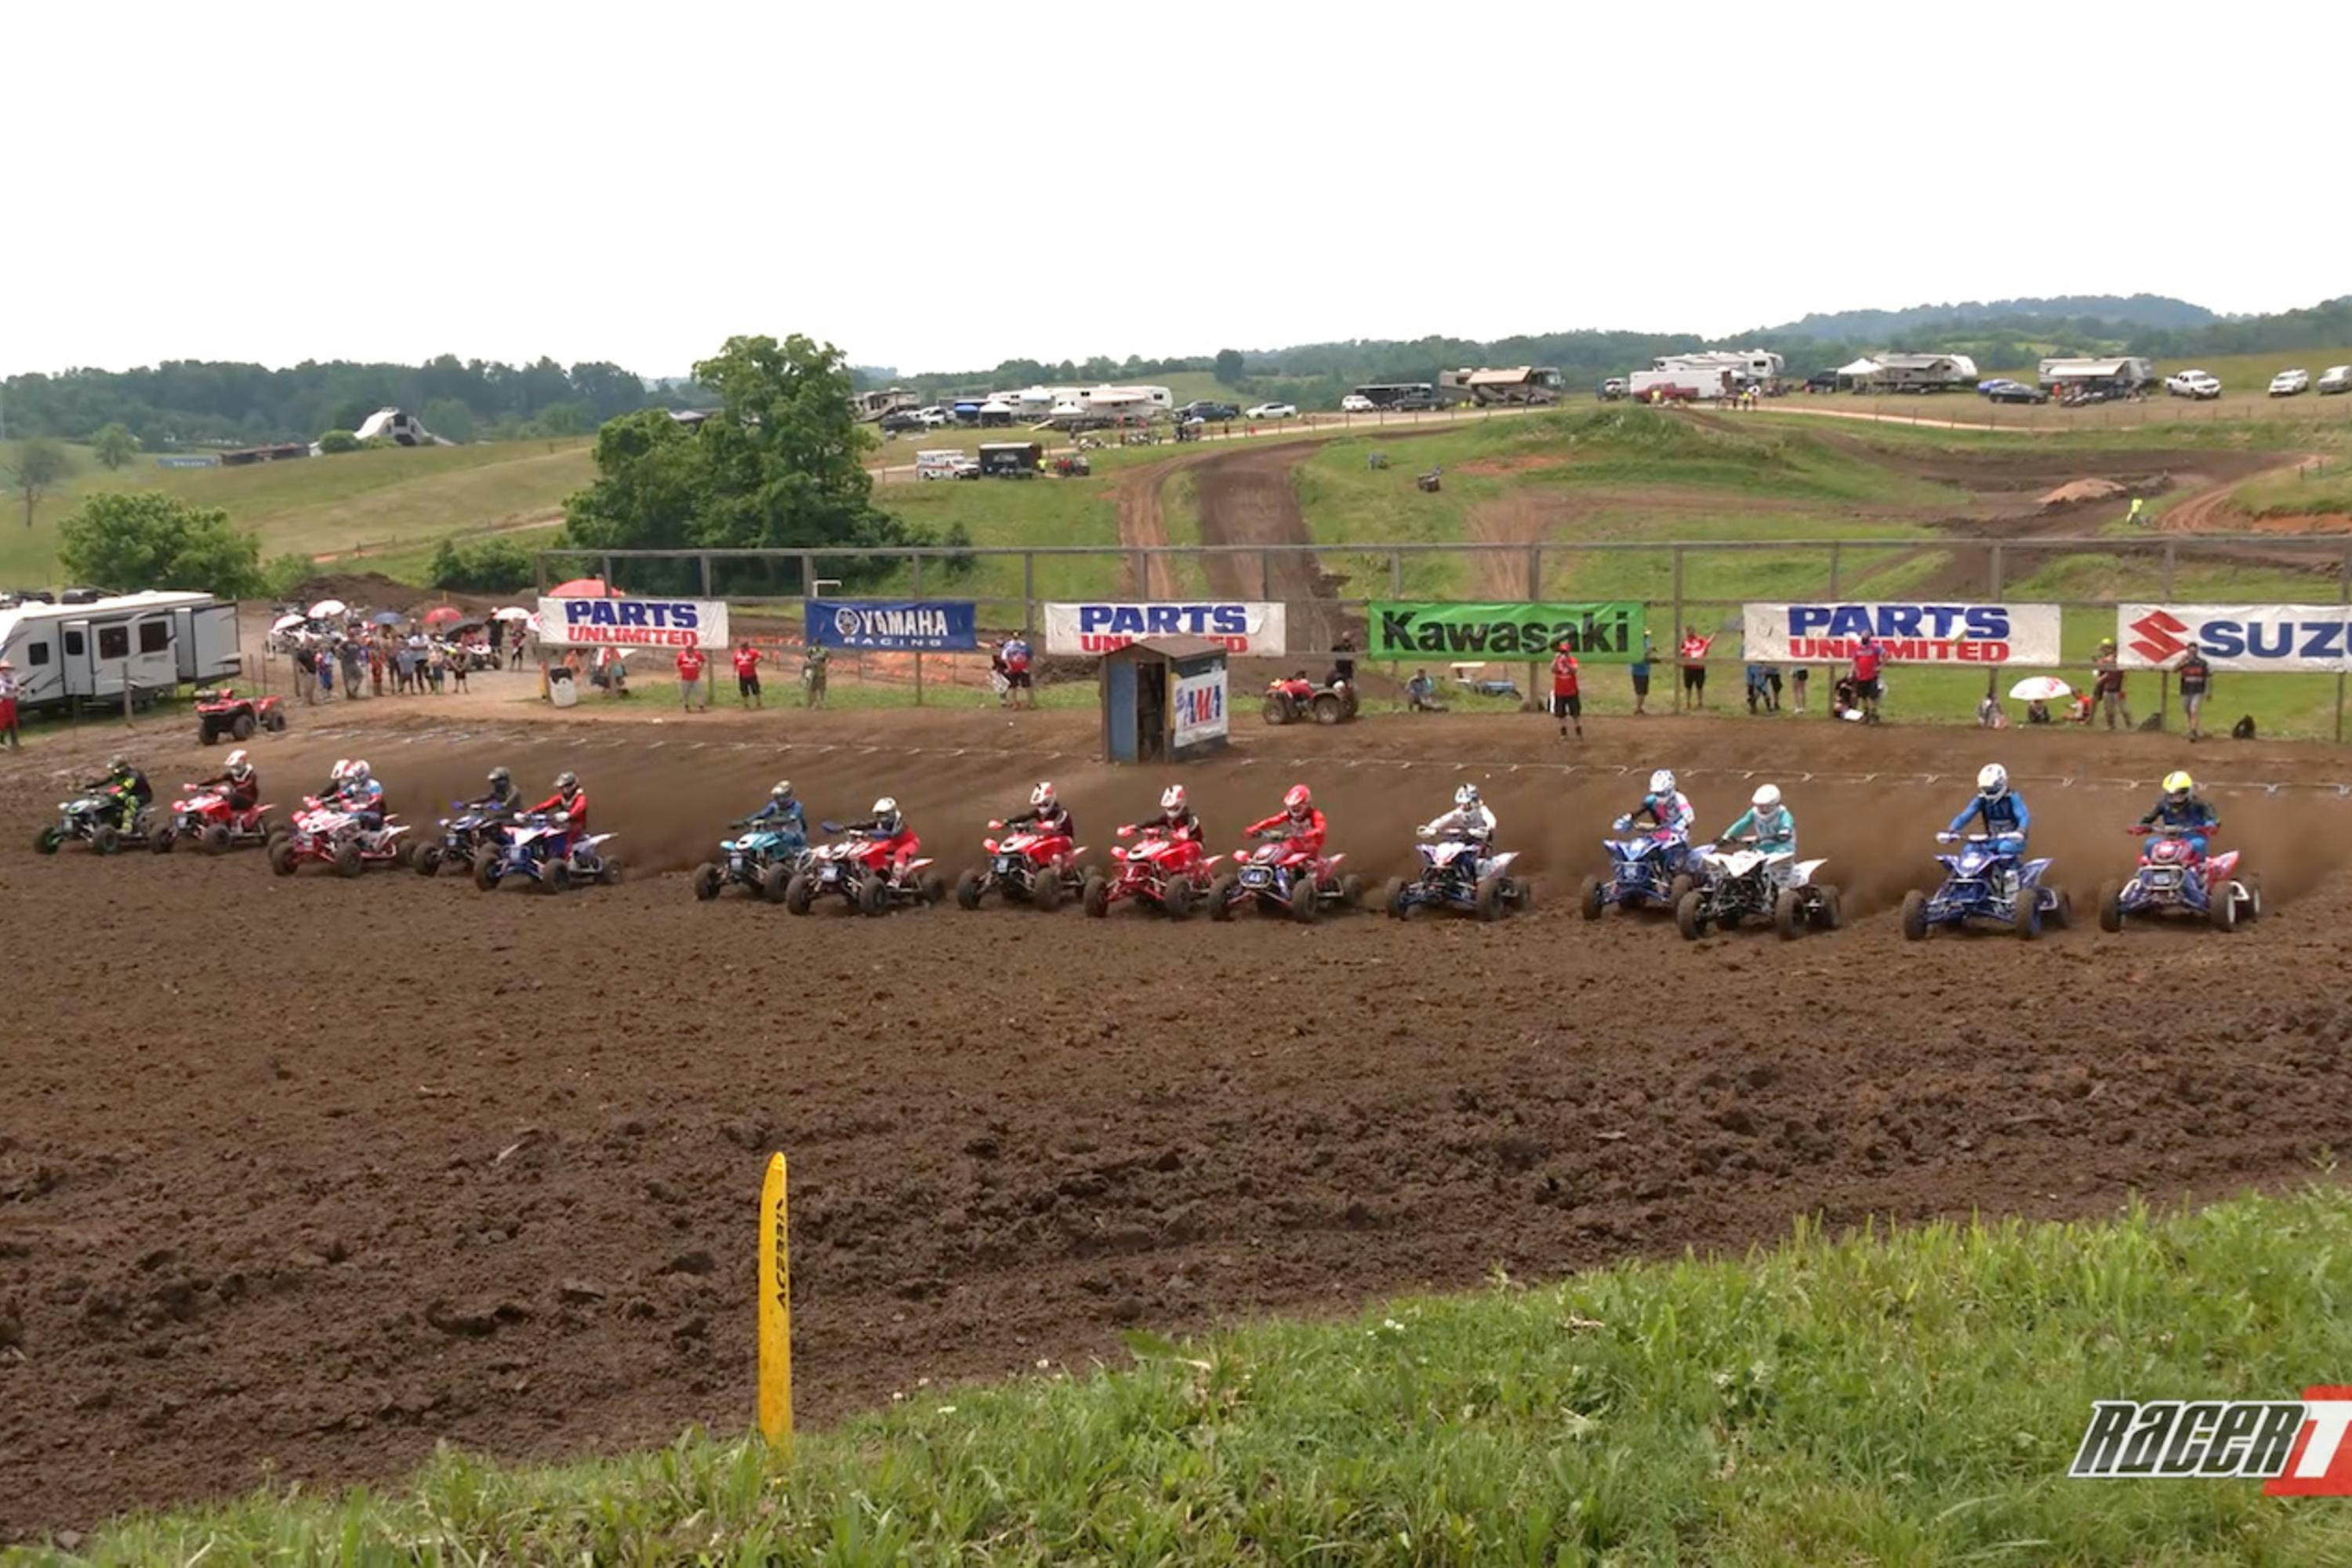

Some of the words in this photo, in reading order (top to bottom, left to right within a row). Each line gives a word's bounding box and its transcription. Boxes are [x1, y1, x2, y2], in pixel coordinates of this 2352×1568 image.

[564, 601, 698, 629] PARTS
[858, 610, 949, 636] YAMAHA
[1080, 605, 1247, 633] PARTS
[1788, 606, 2009, 639] PARTS
[568, 626, 698, 645] UNLIMITED
[844, 637, 942, 647] RACING
[1381, 611, 1628, 654] Kawasaki
[2198, 620, 2352, 658] SUZ
[1789, 639, 2009, 662] UNLMITED
[1184, 684, 1221, 724] AMA
